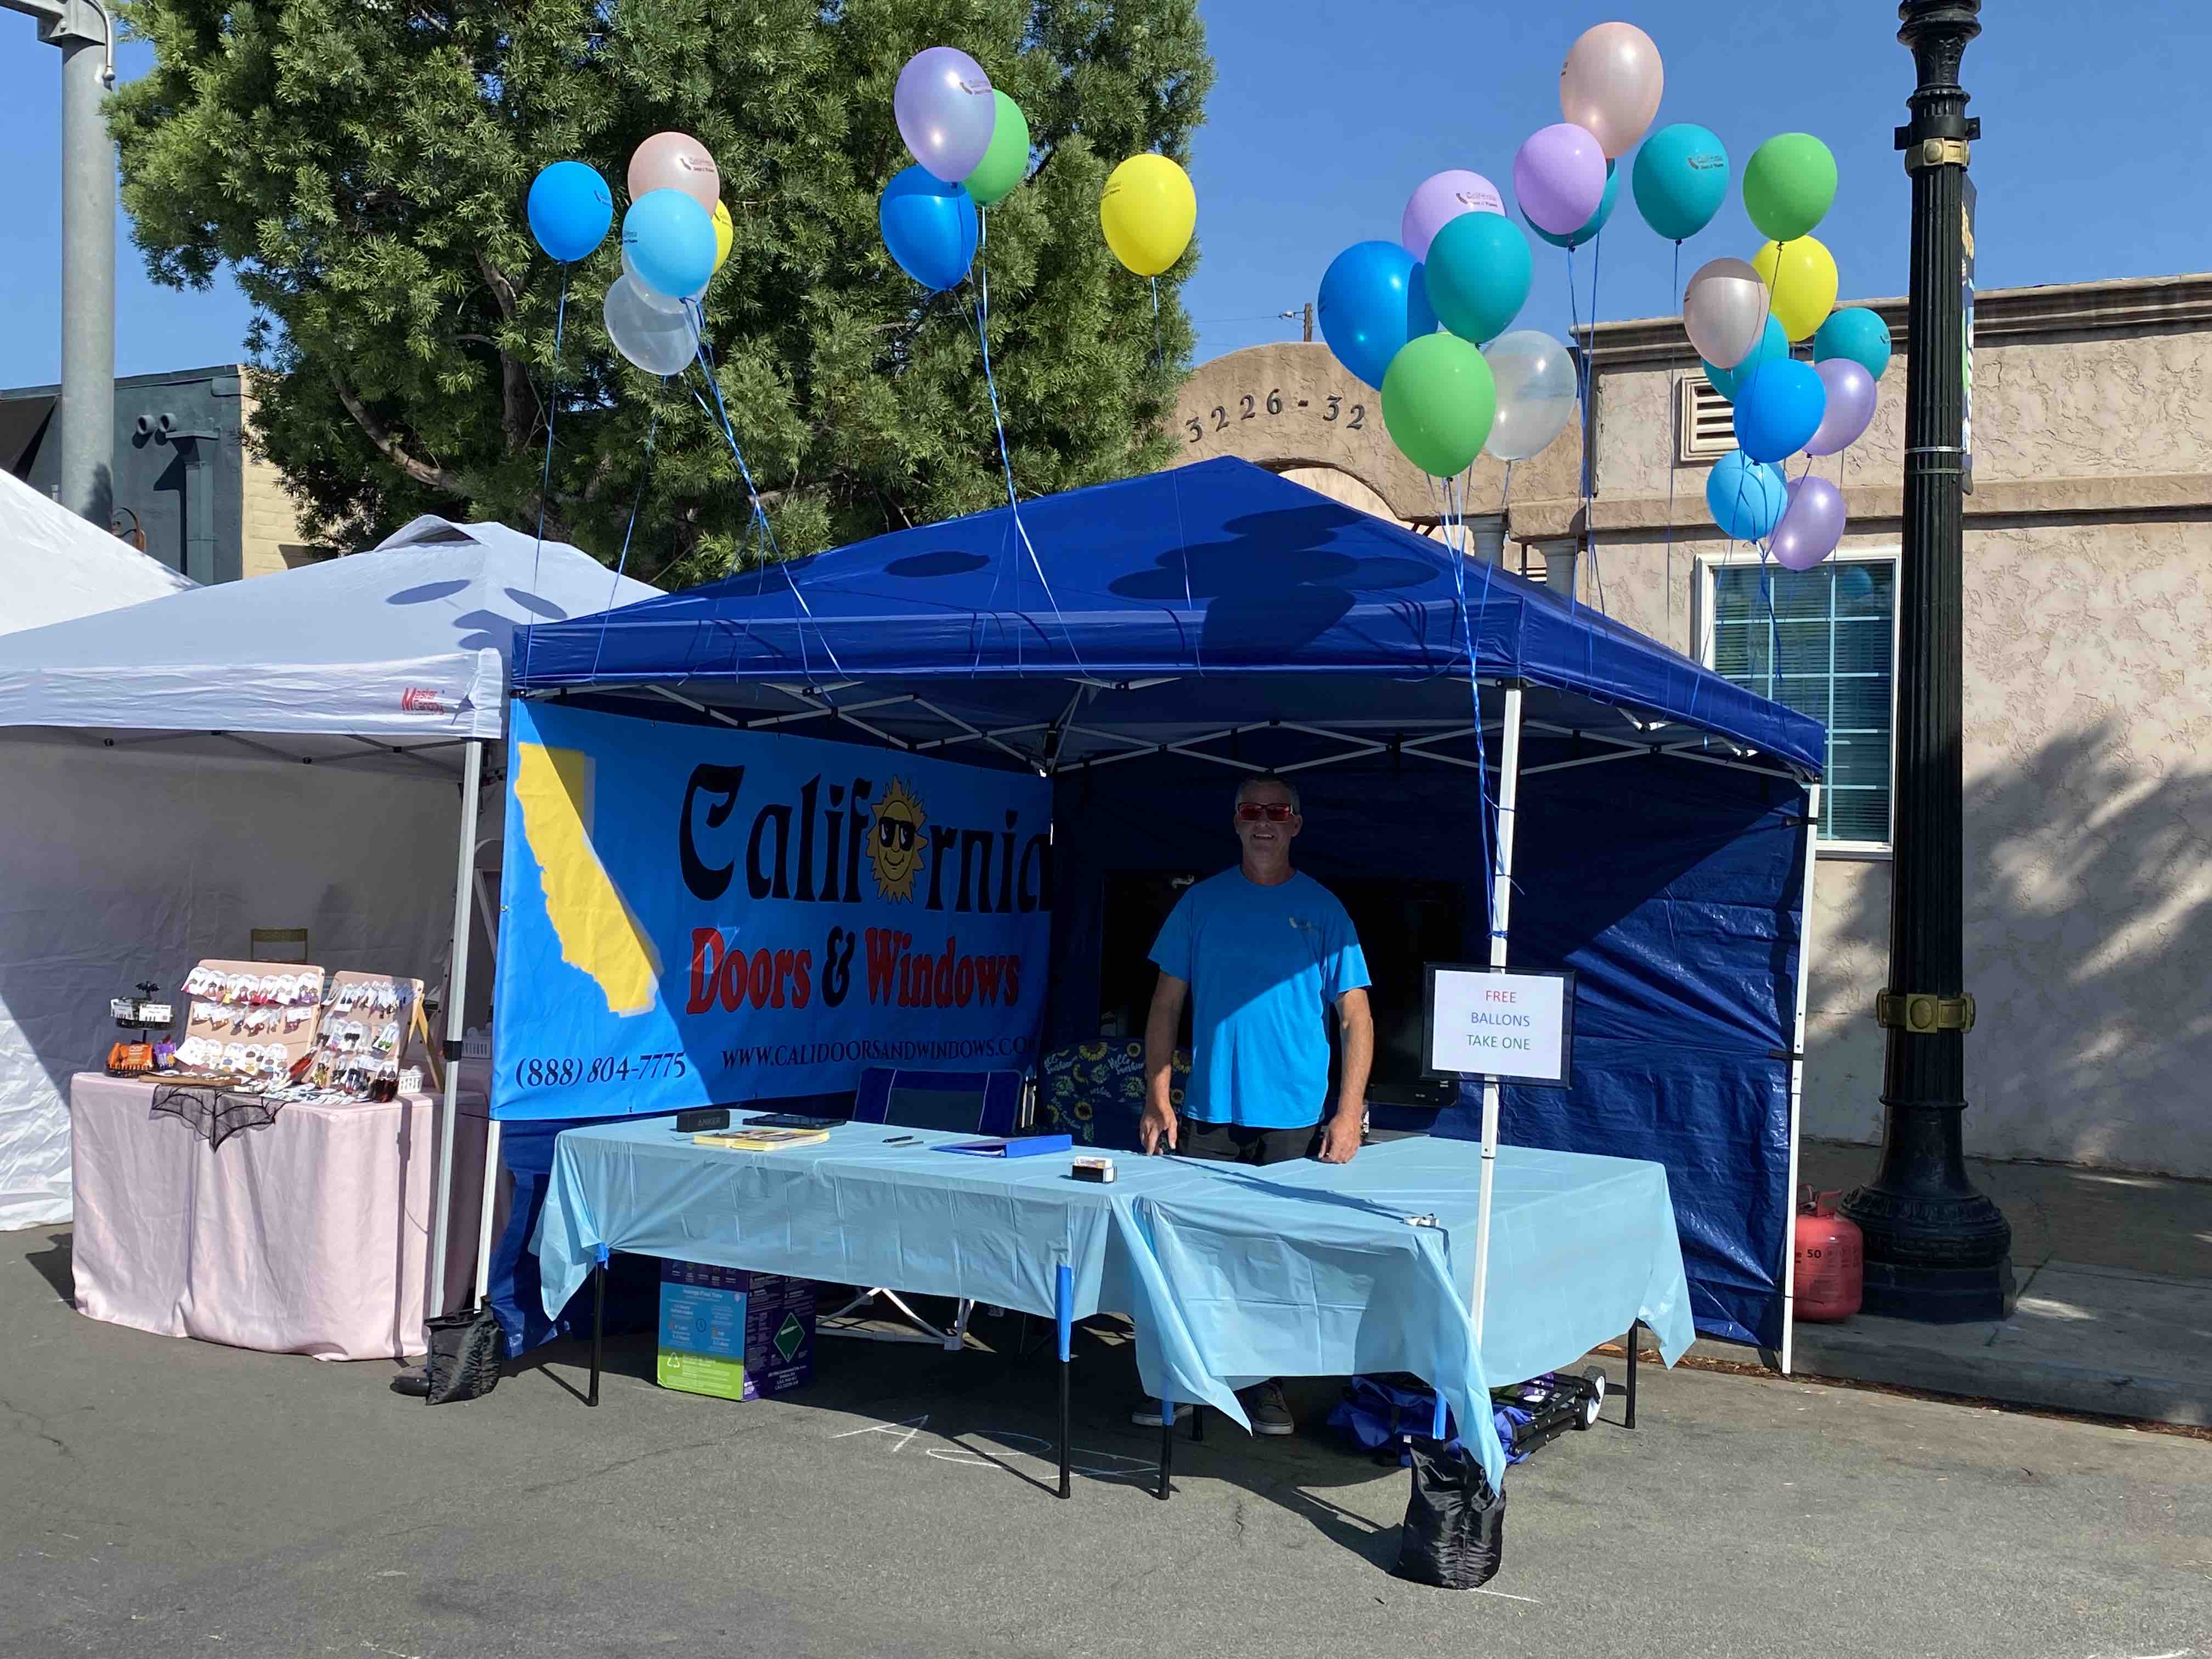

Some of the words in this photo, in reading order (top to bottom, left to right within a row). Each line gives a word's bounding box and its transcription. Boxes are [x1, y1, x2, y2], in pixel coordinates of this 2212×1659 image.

[686, 927, 812, 1014] Doors
[822, 926, 855, 1007] &
[865, 927, 1020, 1008] Windows
[1485, 990, 1517, 1003] FREE
[1471, 1012, 1531, 1027] BALLONS
[1466, 1034, 1498, 1048] TAKE
[1502, 1036, 1531, 1050] ONE
[515, 1057, 584, 1090] (888)
[586, 1052, 687, 1084] 804-7775
[1807, 1249, 1822, 1259] 50
